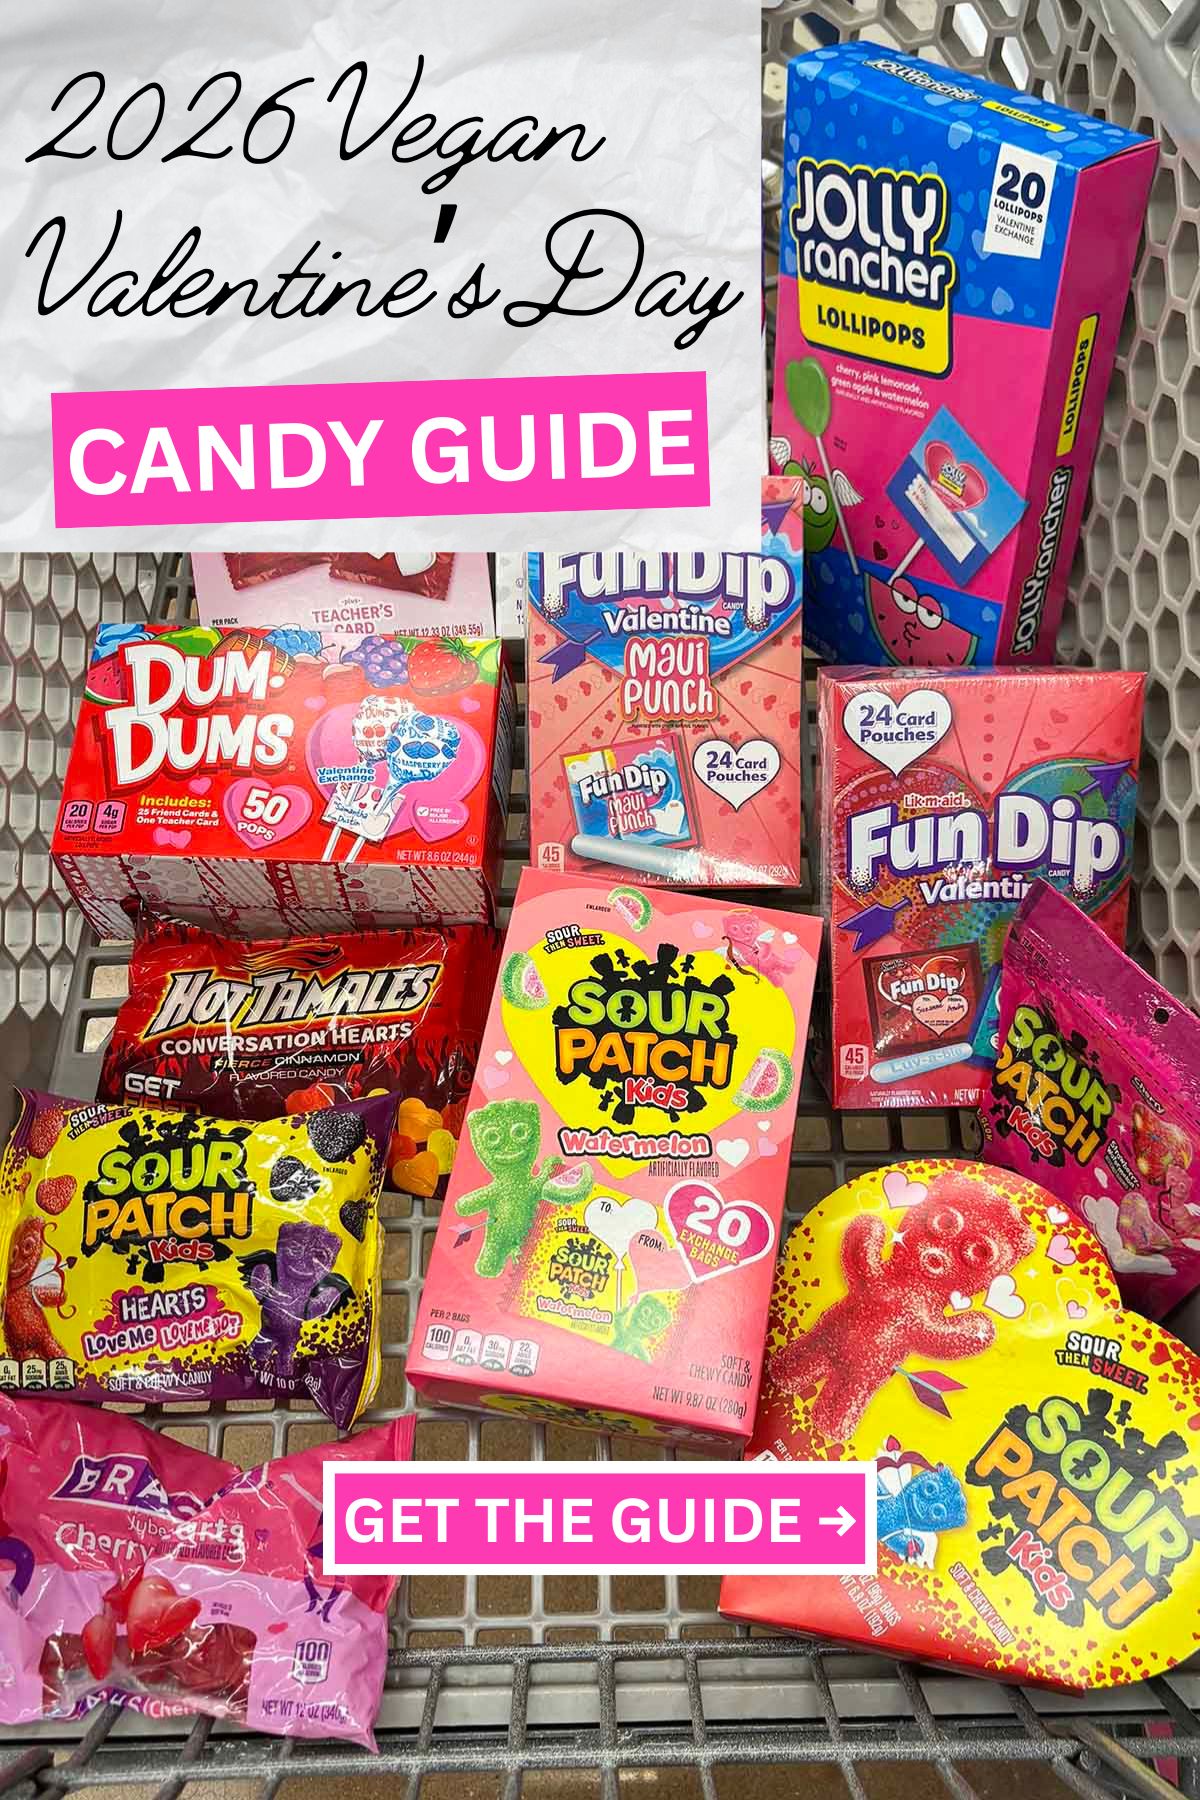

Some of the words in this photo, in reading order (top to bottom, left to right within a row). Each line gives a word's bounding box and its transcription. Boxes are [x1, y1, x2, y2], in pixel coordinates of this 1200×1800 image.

[995, 105, 1052, 128] LOLLIPOPS
[996, 163, 1046, 209] 20
[796, 170, 938, 257] JOLLY
[993, 198, 1043, 223] LOLLIPOPS
[993, 224, 1034, 246] EXCHANGE
[997, 214, 1036, 235] VALENTINE
[802, 238, 946, 301] rancher
[816, 304, 926, 350] LOLLIPOPS
[862, 371, 880, 383] pink
[1064, 338, 1089, 435] LOLLIPOPS
[831, 376, 851, 388] green
[881, 391, 930, 410] watermelon
[543, 552, 664, 616] Fun
[677, 552, 790, 629] Dip
[312, 603, 393, 625] TEACHER'S
[722, 602, 744, 610] CANDY
[212, 618, 223, 627] PER
[224, 617, 239, 626] PACK
[335, 622, 375, 634] CARD
[602, 605, 732, 636] Valentine
[860, 704, 893, 728] 24
[895, 712, 937, 727] Card
[105, 706, 295, 785] DUMS
[860, 729, 936, 743] Pouches
[317, 766, 375, 776] Valentine
[706, 751, 733, 769] 24
[735, 758, 767, 770] Card
[318, 773, 375, 784] Exchange
[579, 771, 623, 806] Fun
[623, 764, 668, 794] Dip
[707, 770, 768, 783] Pouches
[69, 804, 88, 818] 20
[104, 804, 119, 819] 4g
[137, 809, 149, 817] 25
[151, 809, 182, 817] Friend
[182, 810, 210, 818] Cards
[140, 795, 212, 808] Includes:
[243, 788, 289, 825] 50
[136, 817, 155, 825] One
[157, 817, 196, 826] Teacher
[196, 818, 219, 827] Card
[236, 821, 276, 842] POPS
[396, 850, 411, 859] NET
[413, 850, 427, 861] WT
[427, 851, 440, 861] 8.6
[441, 851, 451, 861] OZ
[452, 852, 478, 863] (244g)
[542, 846, 560, 862] 45
[850, 805, 983, 888] Fun
[998, 795, 1121, 896] Dip
[1048, 869, 1071, 877] CANDY
[546, 925, 581, 944] SOUR
[544, 940, 567, 954] THEN
[890, 978, 926, 1001] Fun
[926, 972, 960, 995] Dip
[567, 982, 728, 1039] SOUR
[161, 1031, 328, 1056] CONVERSATION
[331, 1022, 413, 1046] HEARTS
[215, 1058, 271, 1069] FIERCE
[274, 1052, 361, 1067] CINNAMON
[557, 1028, 732, 1088] PATCH
[845, 1047, 864, 1065] 45
[1008, 1007, 1112, 1129] SOUR
[124, 1073, 182, 1100] GET
[229, 1069, 296, 1082] FLAVORED
[298, 1067, 345, 1079] CANDY
[625, 1078, 688, 1109] Kids
[70, 1104, 107, 1127] SOUR
[68, 1121, 92, 1139] THEN
[1007, 1105, 1056, 1157] Kids
[562, 1129, 710, 1158] Watermelon
[98, 1140, 243, 1197] SOUR
[649, 1160, 687, 1178] ARTIFICIALLY
[689, 1160, 720, 1179] FLAVORED
[85, 1191, 252, 1247] PATCH
[600, 1201, 614, 1214] TO:
[685, 1195, 752, 1247] 20
[150, 1238, 215, 1262] Kids
[638, 1234, 665, 1252] FROM:
[680, 1228, 740, 1264] EXCHANGE
[556, 1246, 609, 1274] SOUR
[689, 1246, 721, 1269] BAGS
[550, 1263, 607, 1292] PATCH
[121, 1286, 206, 1322] HEARTS
[537, 1297, 612, 1323] Watermelon
[430, 1327, 451, 1344] 100
[1067, 1331, 1121, 1362] SOUR
[721, 1354, 744, 1372] SOFT
[744, 1360, 750, 1373] &
[1056, 1351, 1091, 1368] THEN
[1092, 1356, 1148, 1395] SWEET.
[108, 1376, 133, 1392] SOFT
[182, 1370, 213, 1388] CANDY
[690, 1363, 721, 1382] CHEWY
[722, 1370, 752, 1389] CANDY
[652, 1386, 669, 1402] NET
[671, 1388, 684, 1405] WT
[686, 1391, 704, 1409] 9.87
[705, 1395, 719, 1412] OZ
[720, 1398, 747, 1420] (280g)
[1025, 1399, 1190, 1578] SOUR
[975, 1427, 1156, 1624] PATCH
[55, 1522, 154, 1563] Cherry
[1007, 1531, 1074, 1611] Kids
[848, 1585, 864, 1602] 6.8
[950, 1563, 971, 1587] SOFT
[967, 1587, 996, 1622] CHEWY
[987, 1615, 1016, 1647] CANDY
[857, 1599, 872, 1615] OZ
[879, 1600, 902, 1627] BAGS
[863, 1610, 889, 1637] (192g)
[297, 1641, 329, 1661] 100
